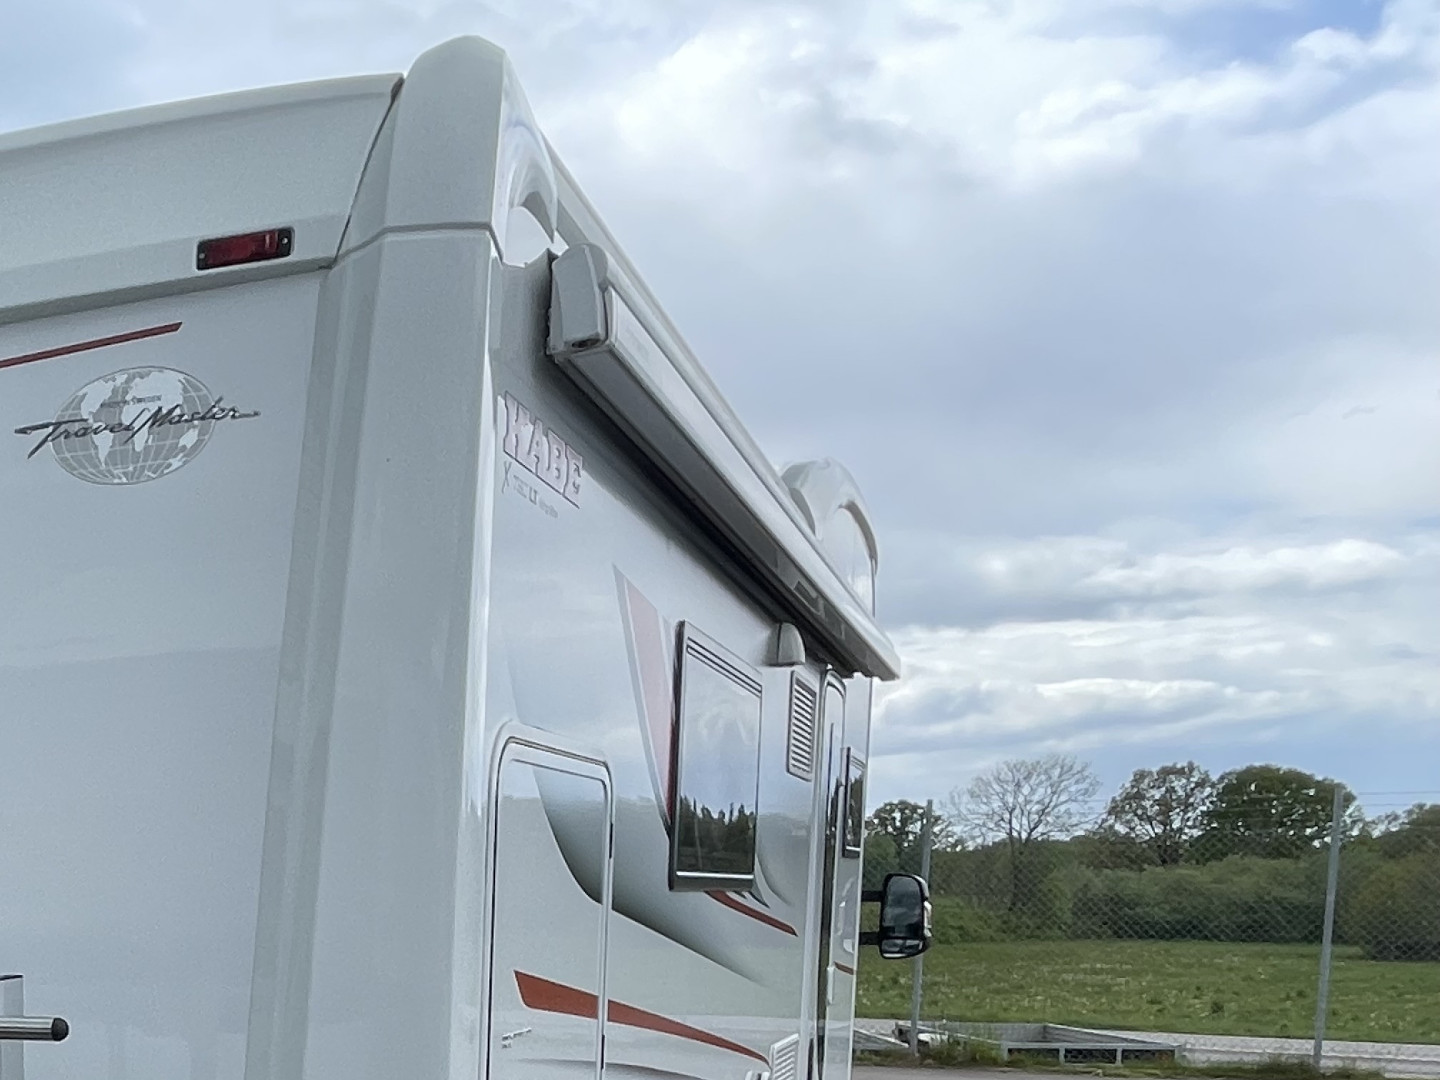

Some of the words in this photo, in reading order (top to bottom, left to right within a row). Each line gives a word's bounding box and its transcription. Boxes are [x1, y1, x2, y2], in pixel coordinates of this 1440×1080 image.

[14, 407, 151, 460] Travel
[122, 396, 262, 445] Master
[503, 390, 584, 509] KABE
